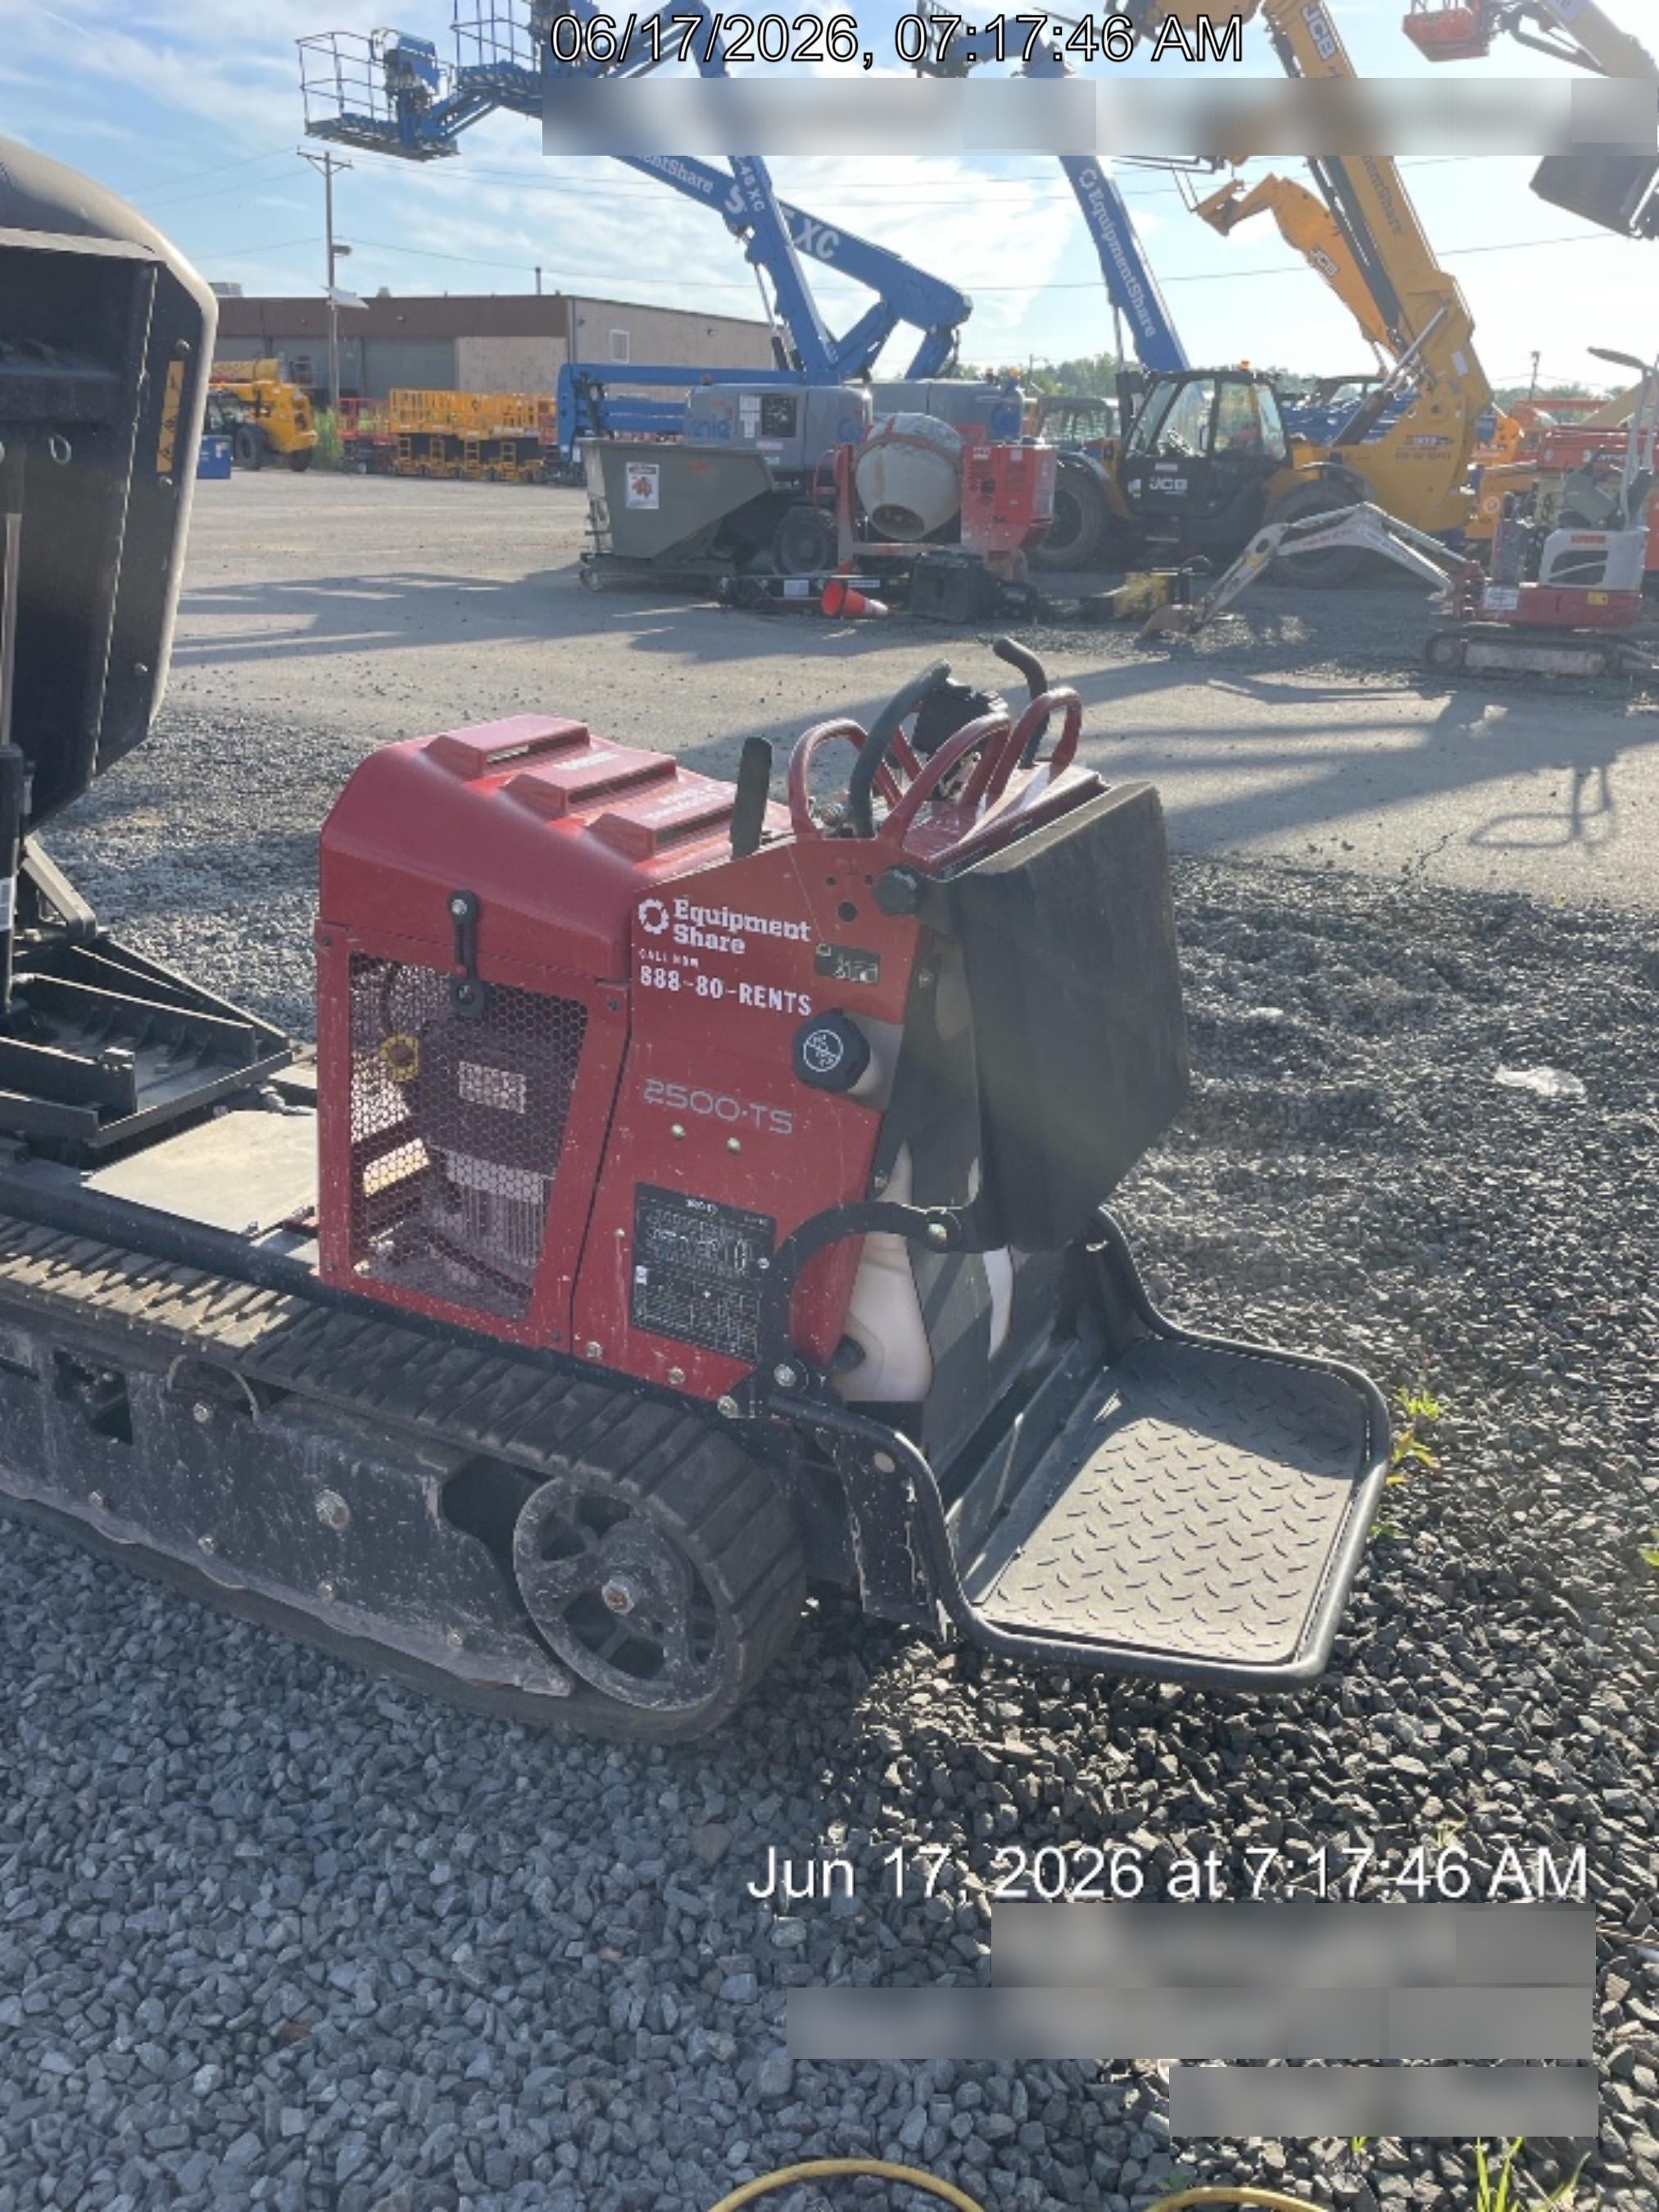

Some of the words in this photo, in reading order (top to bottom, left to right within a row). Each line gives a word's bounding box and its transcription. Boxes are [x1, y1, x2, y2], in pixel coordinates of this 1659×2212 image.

[1302, 3, 1337, 61] JCB
[793, 218, 840, 259] XC
[1088, 187, 1156, 337] EquipmentShare
[1149, 476, 1188, 490] JCB
[673, 898, 811, 941] Equipment
[673, 923, 746, 954] Share
[640, 965, 812, 1016] 888-80-RENTS
